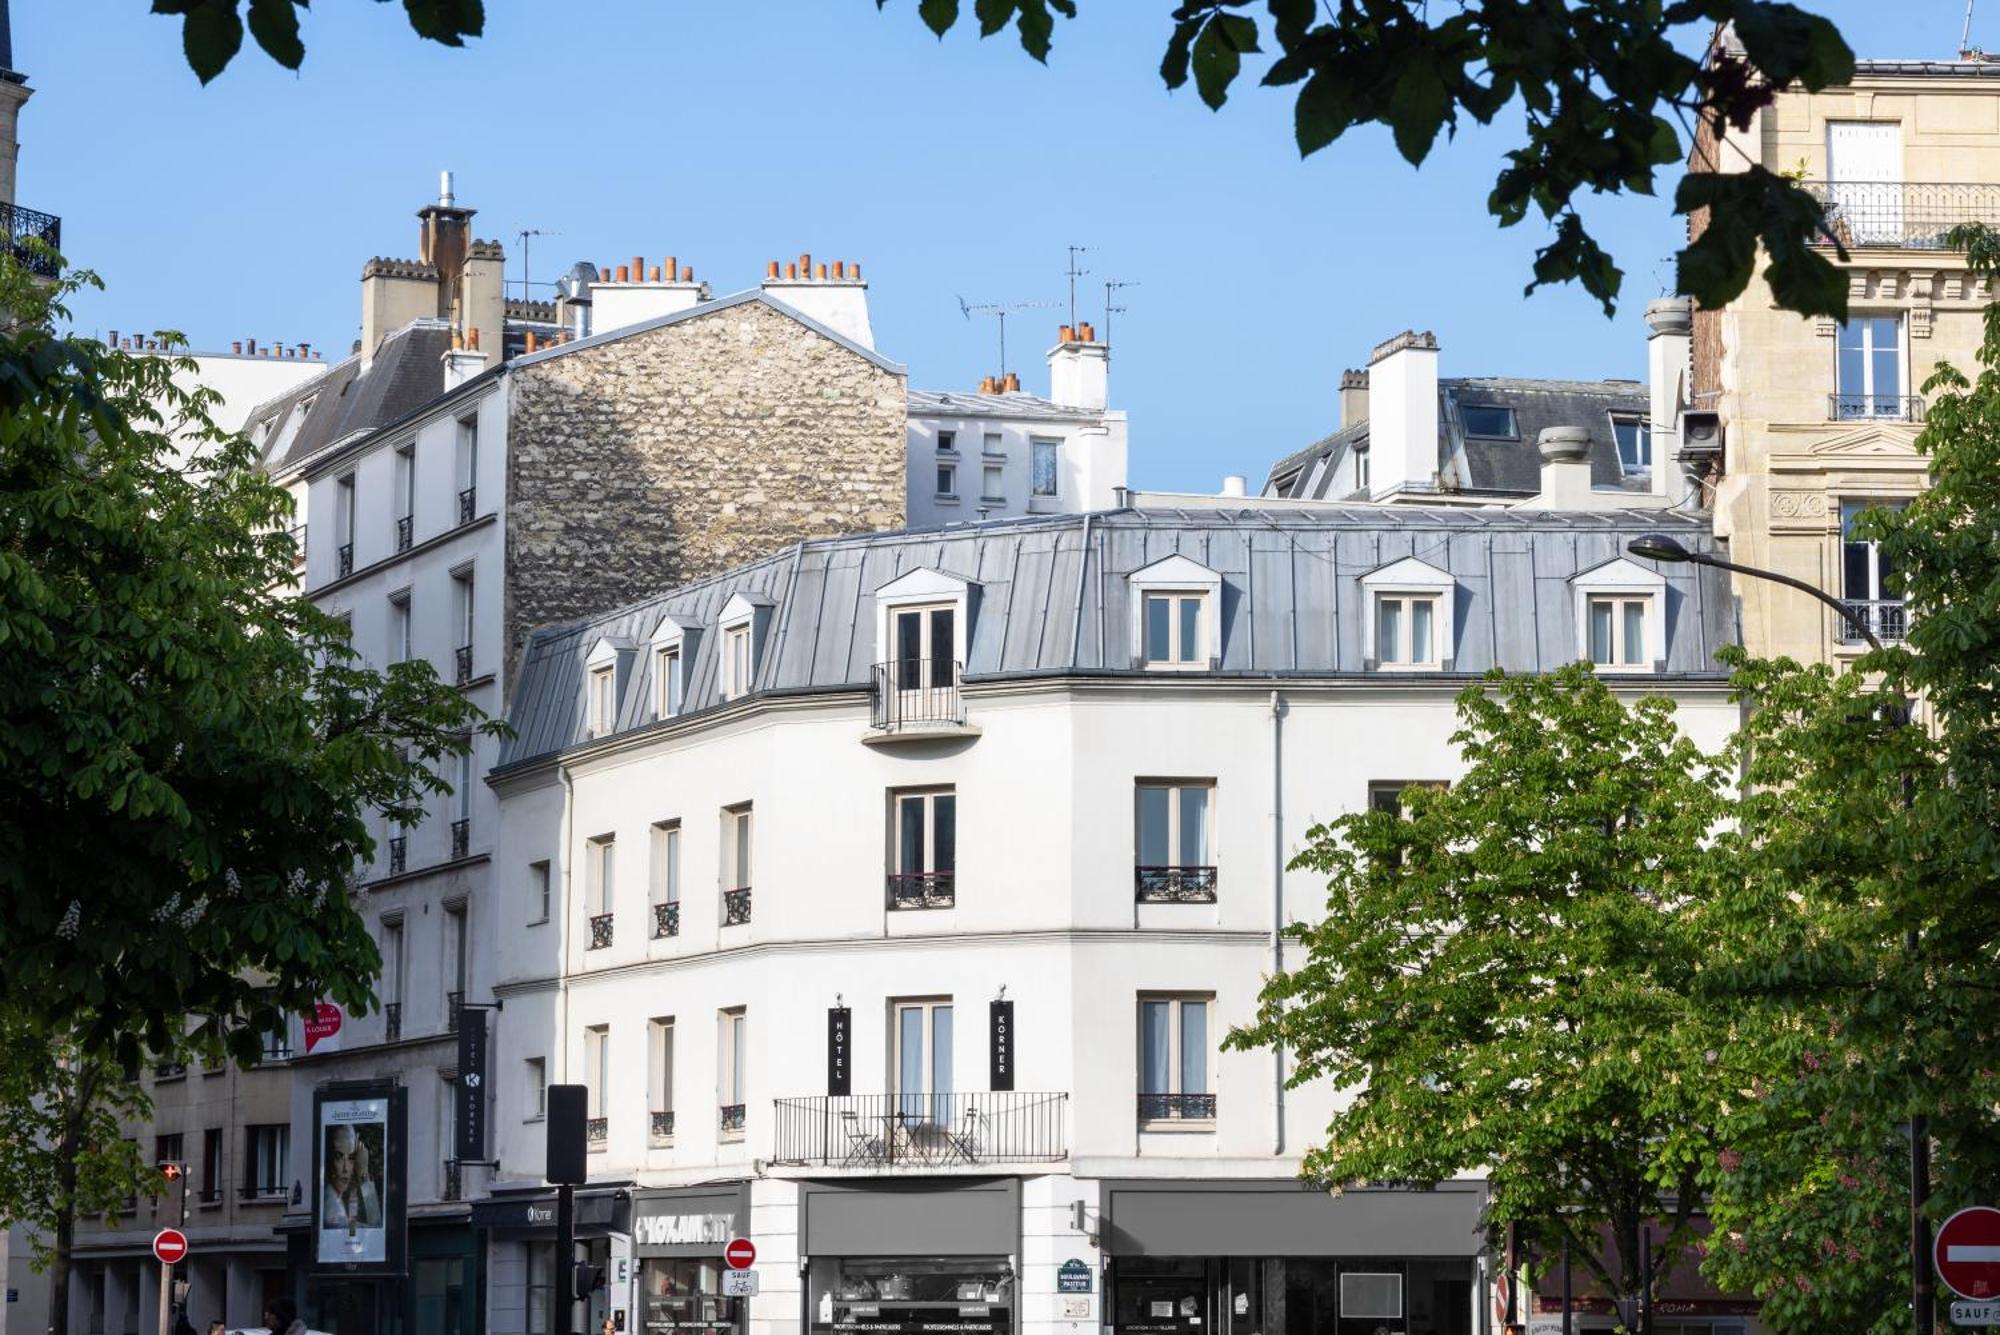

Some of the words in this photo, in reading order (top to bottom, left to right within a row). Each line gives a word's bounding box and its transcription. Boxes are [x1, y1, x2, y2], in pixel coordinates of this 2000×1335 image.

[835, 1021, 843, 1079] HÔTEL
[998, 1015, 1006, 1073] KORNER
[1955, 1308, 1990, 1319] SAUF
